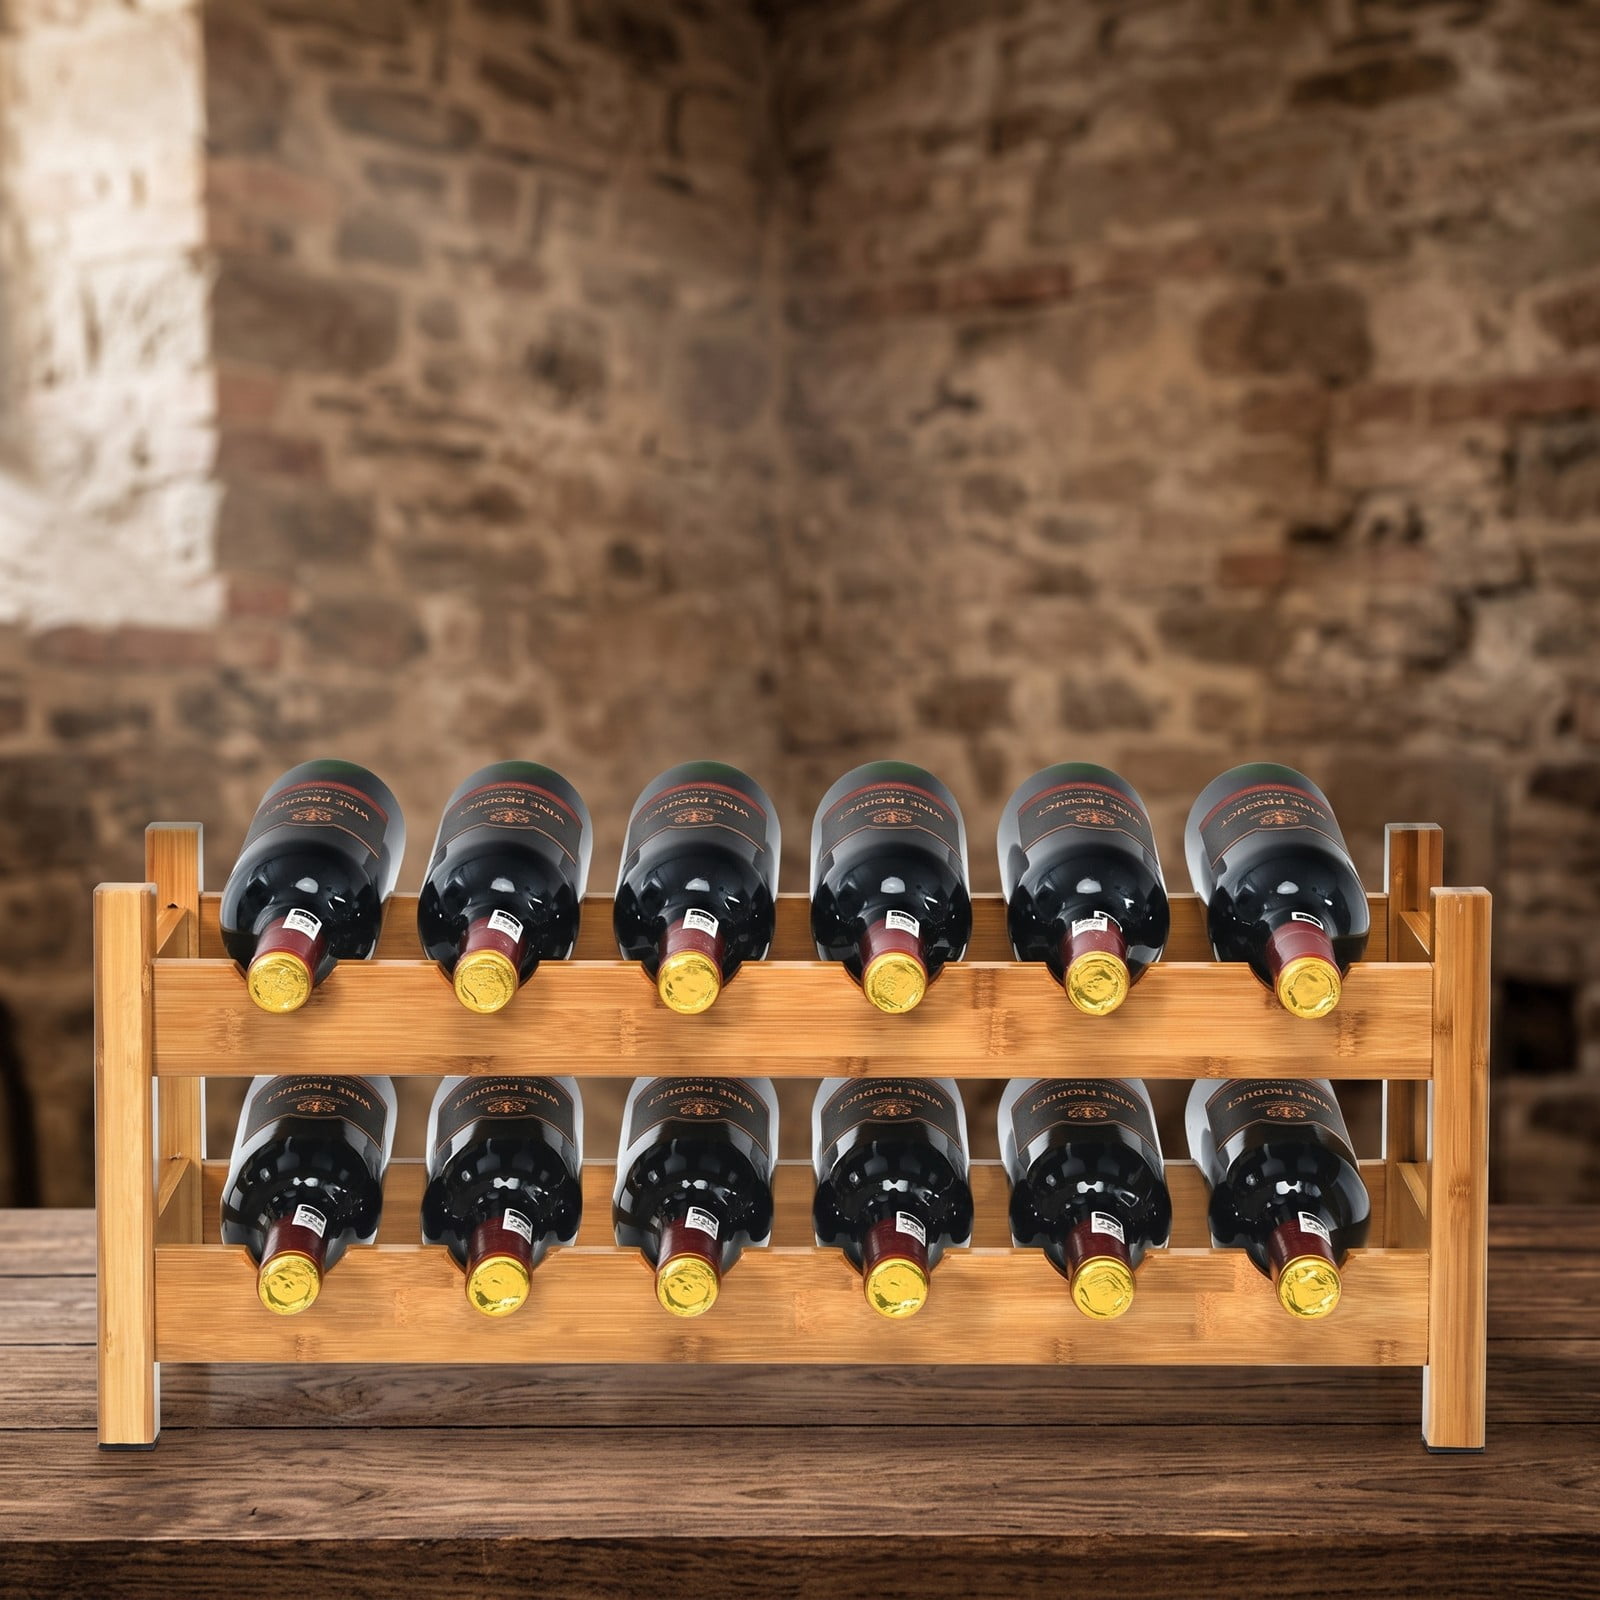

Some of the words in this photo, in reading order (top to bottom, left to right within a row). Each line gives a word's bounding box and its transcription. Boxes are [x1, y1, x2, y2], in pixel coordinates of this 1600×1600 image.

[265, 1083, 332, 1104] PRODUCT
[336, 1085, 372, 1110] WINE
[453, 1083, 519, 1109] PRODUCT
[523, 1085, 560, 1106] WINE
[648, 1085, 714, 1108] PRODUCT
[718, 1088, 754, 1112] WINE
[837, 1085, 903, 1113] PRODUCT
[907, 1088, 943, 1110] WINE
[1030, 1089, 1097, 1113] PRODUCT
[1101, 1090, 1138, 1112] WINE
[1225, 1088, 1292, 1110] PRODUCT
[1296, 1090, 1332, 1113] WINE
